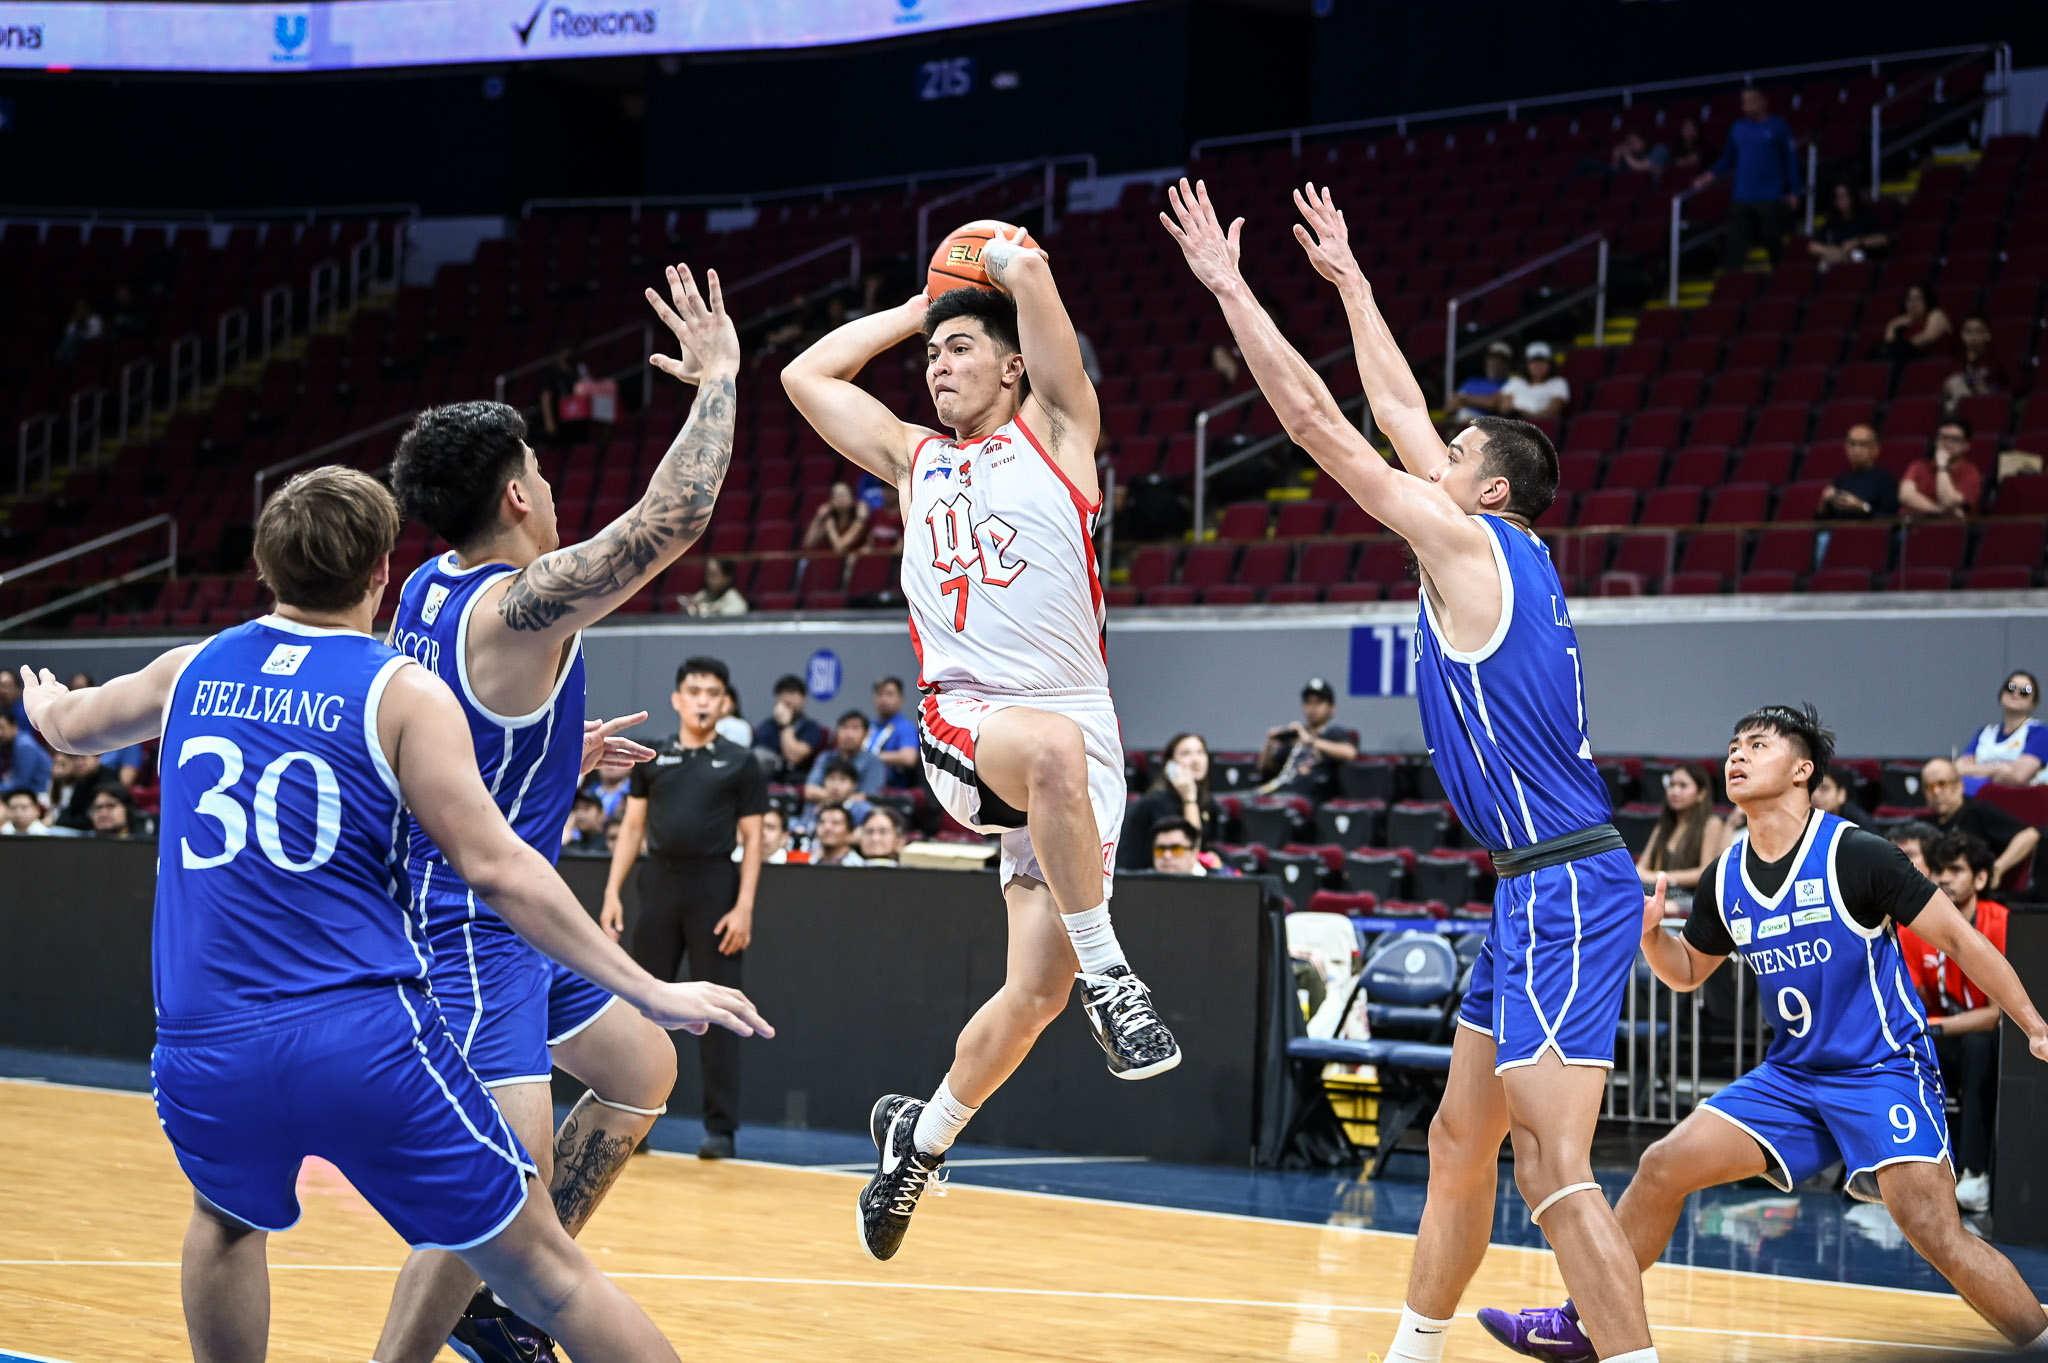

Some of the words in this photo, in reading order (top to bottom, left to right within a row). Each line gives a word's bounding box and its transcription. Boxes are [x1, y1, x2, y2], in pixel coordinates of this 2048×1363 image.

[551, 7, 655, 37] Rexona
[920, 57, 971, 99] 215
[985, 443, 1003, 456] ANTA
[940, 574, 970, 633] 7
[190, 680, 344, 732] FJELLVANG
[178, 735, 342, 872] 30
[1767, 921, 1787, 932] Smart
[1777, 986, 1812, 1039] 9
[1888, 1103, 1917, 1144] 9
